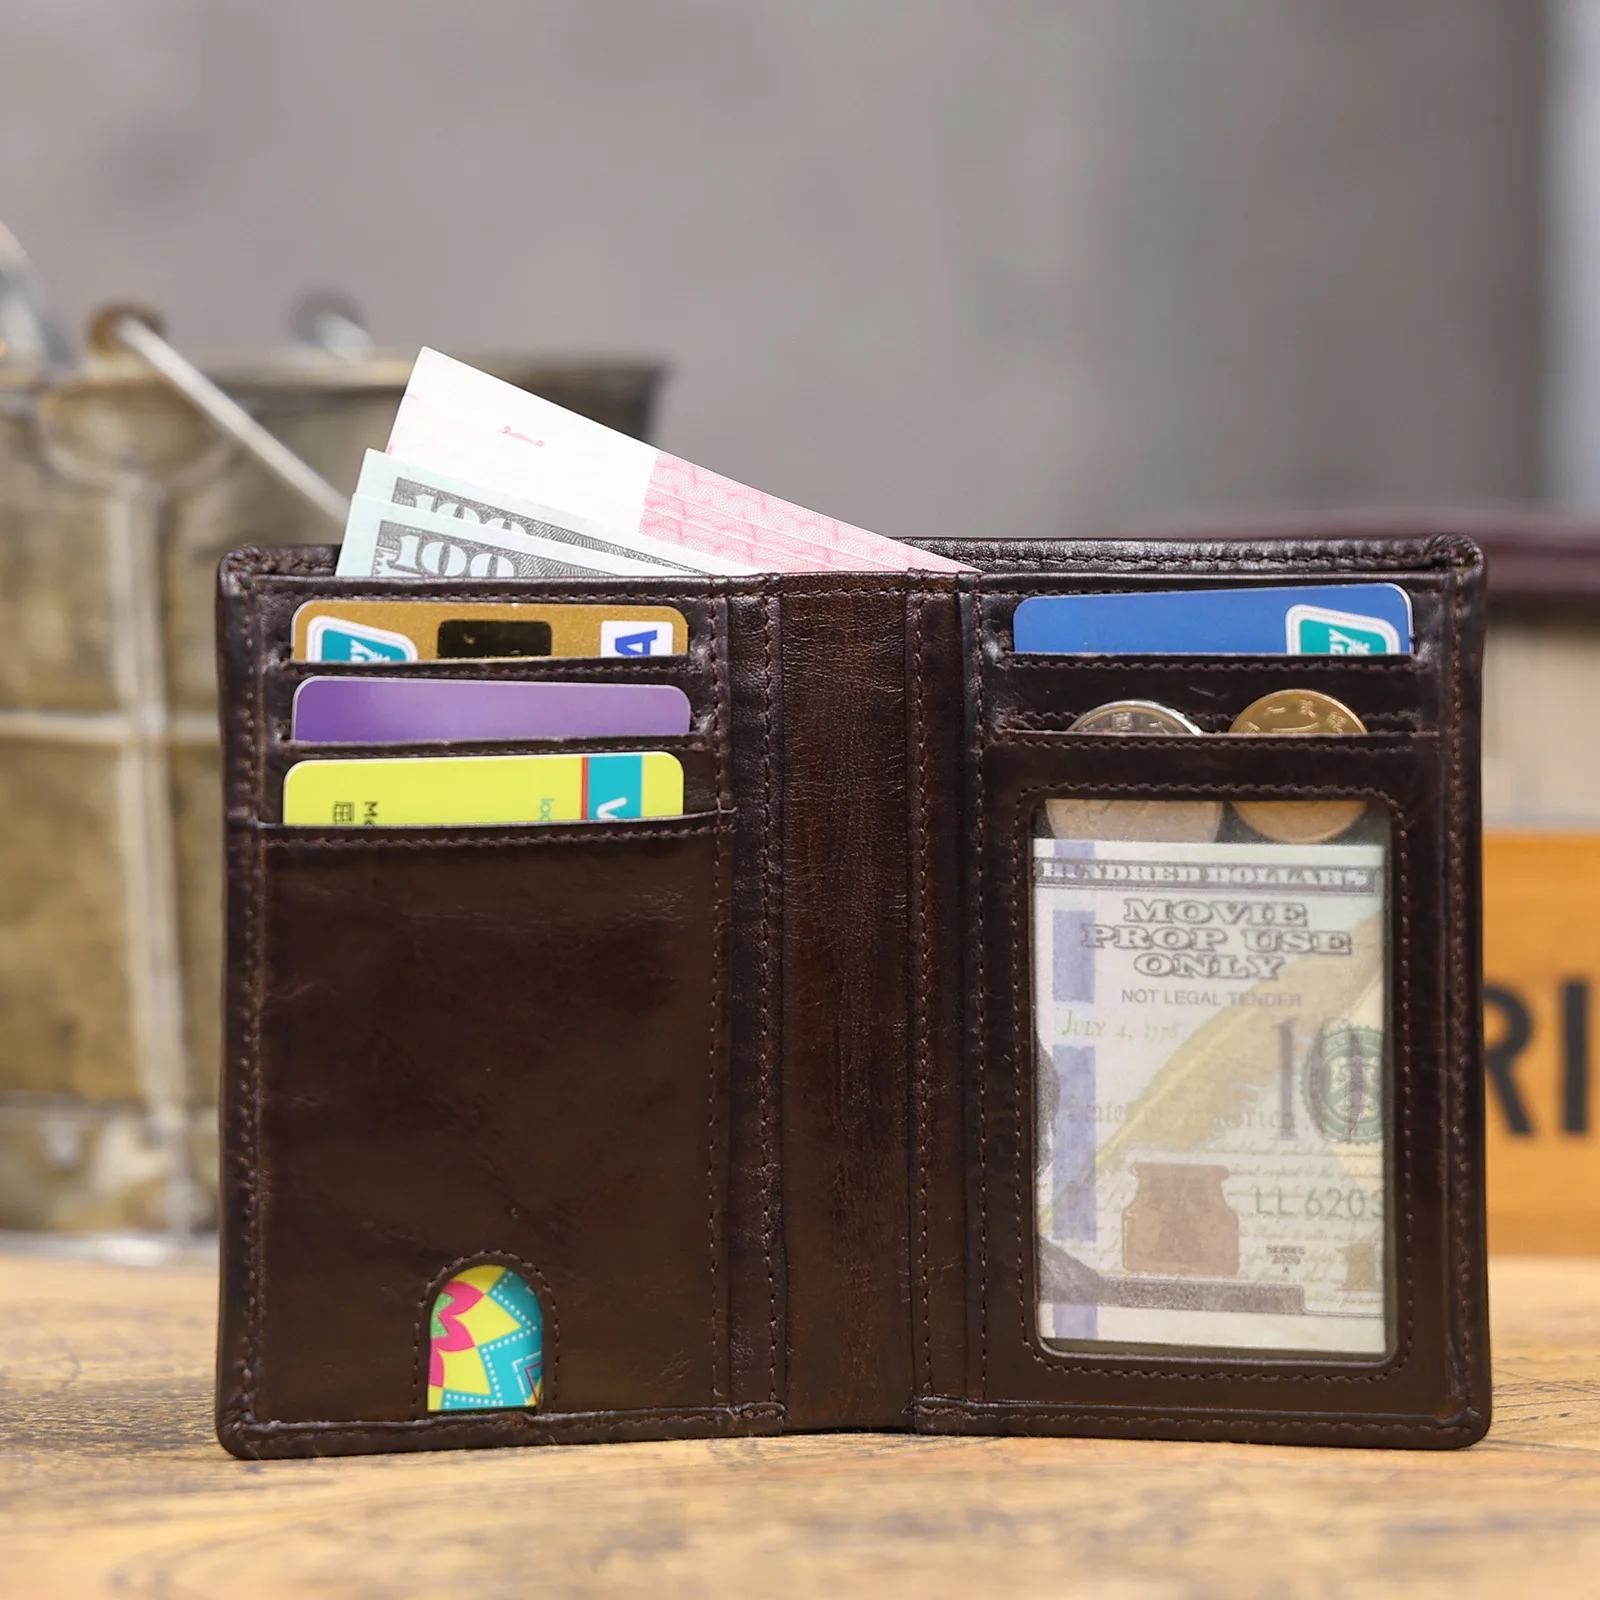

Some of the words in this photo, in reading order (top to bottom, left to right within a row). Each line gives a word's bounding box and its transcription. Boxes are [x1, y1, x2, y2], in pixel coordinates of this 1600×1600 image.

[387, 533, 516, 577] 100
[1206, 866, 1369, 887] DOLLARS
[1123, 898, 1308, 927] MOVIE
[1081, 924, 1228, 951] PROP
[1240, 929, 1352, 955] USE
[1134, 952, 1286, 980] ONLY
[1121, 988, 1159, 1004] NOT
[1164, 990, 1221, 1006] LEGAL
[1228, 992, 1303, 1009] TENDER
